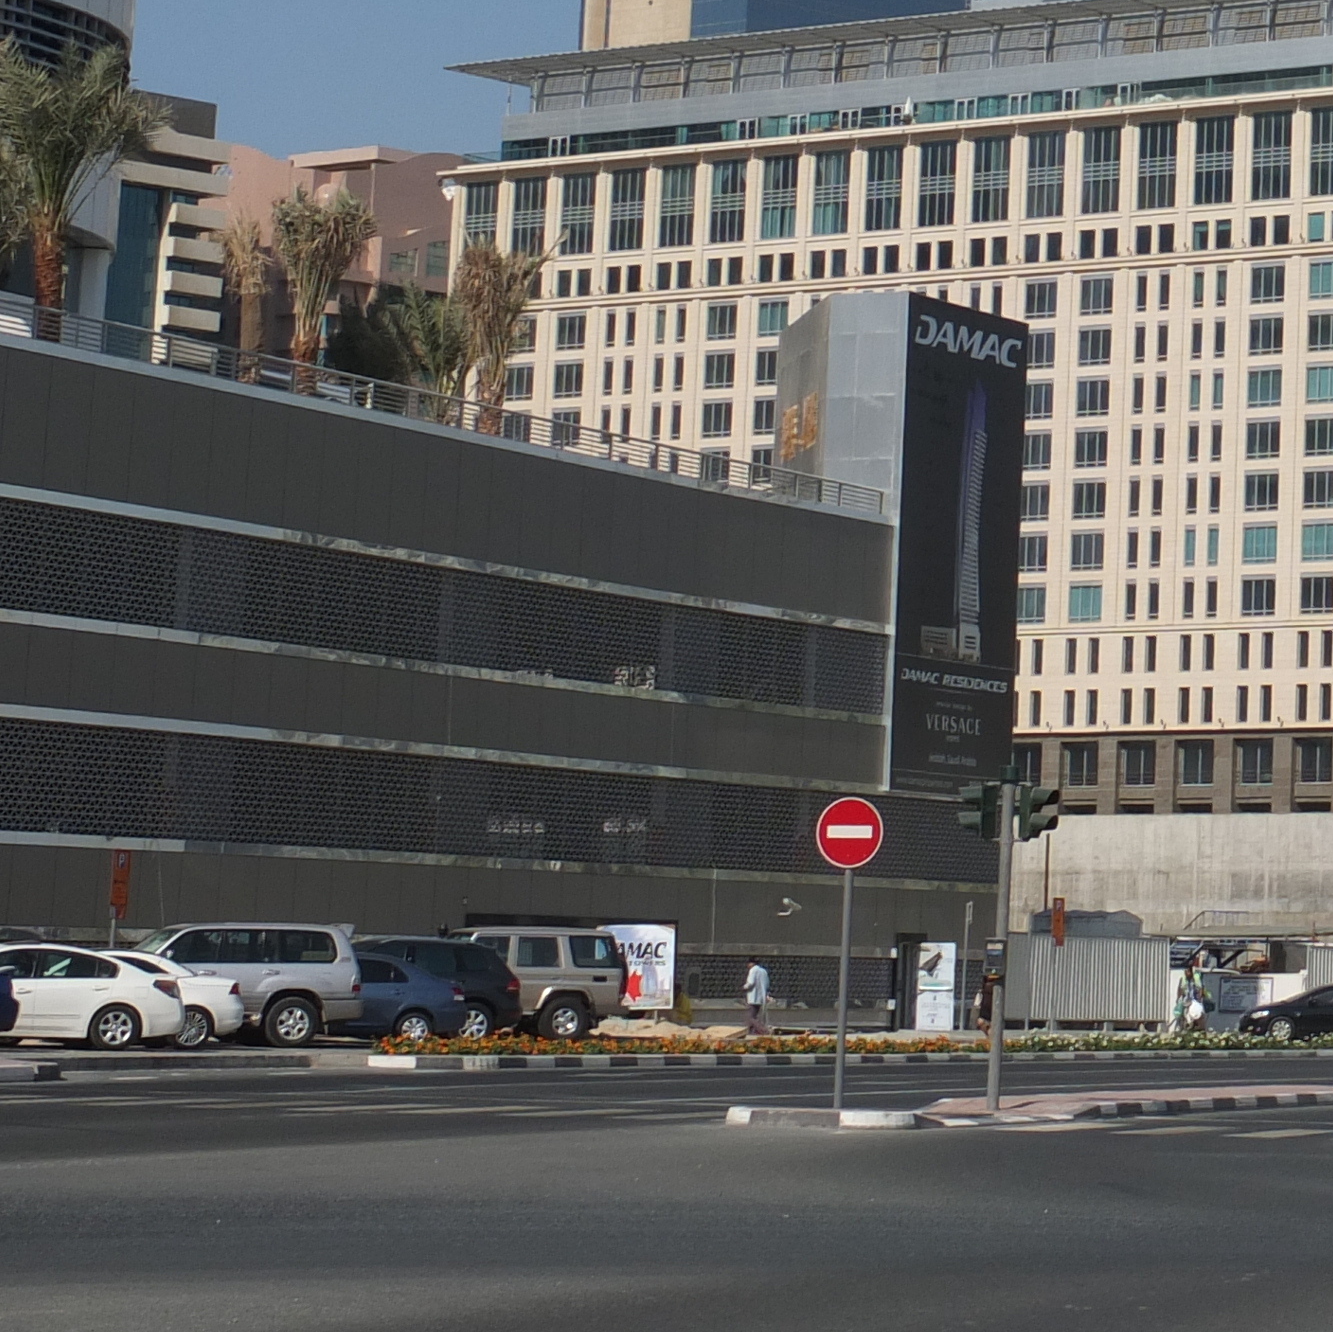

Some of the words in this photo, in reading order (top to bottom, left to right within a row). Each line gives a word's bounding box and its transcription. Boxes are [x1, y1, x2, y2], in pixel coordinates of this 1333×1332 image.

[914, 314, 1022, 368] DAMAC
[900, 667, 940, 685] DAMAC
[942, 673, 1008, 694] RESIDENCES
[925, 713, 982, 736] VERSACE
[616, 942, 667, 959] AMAC
